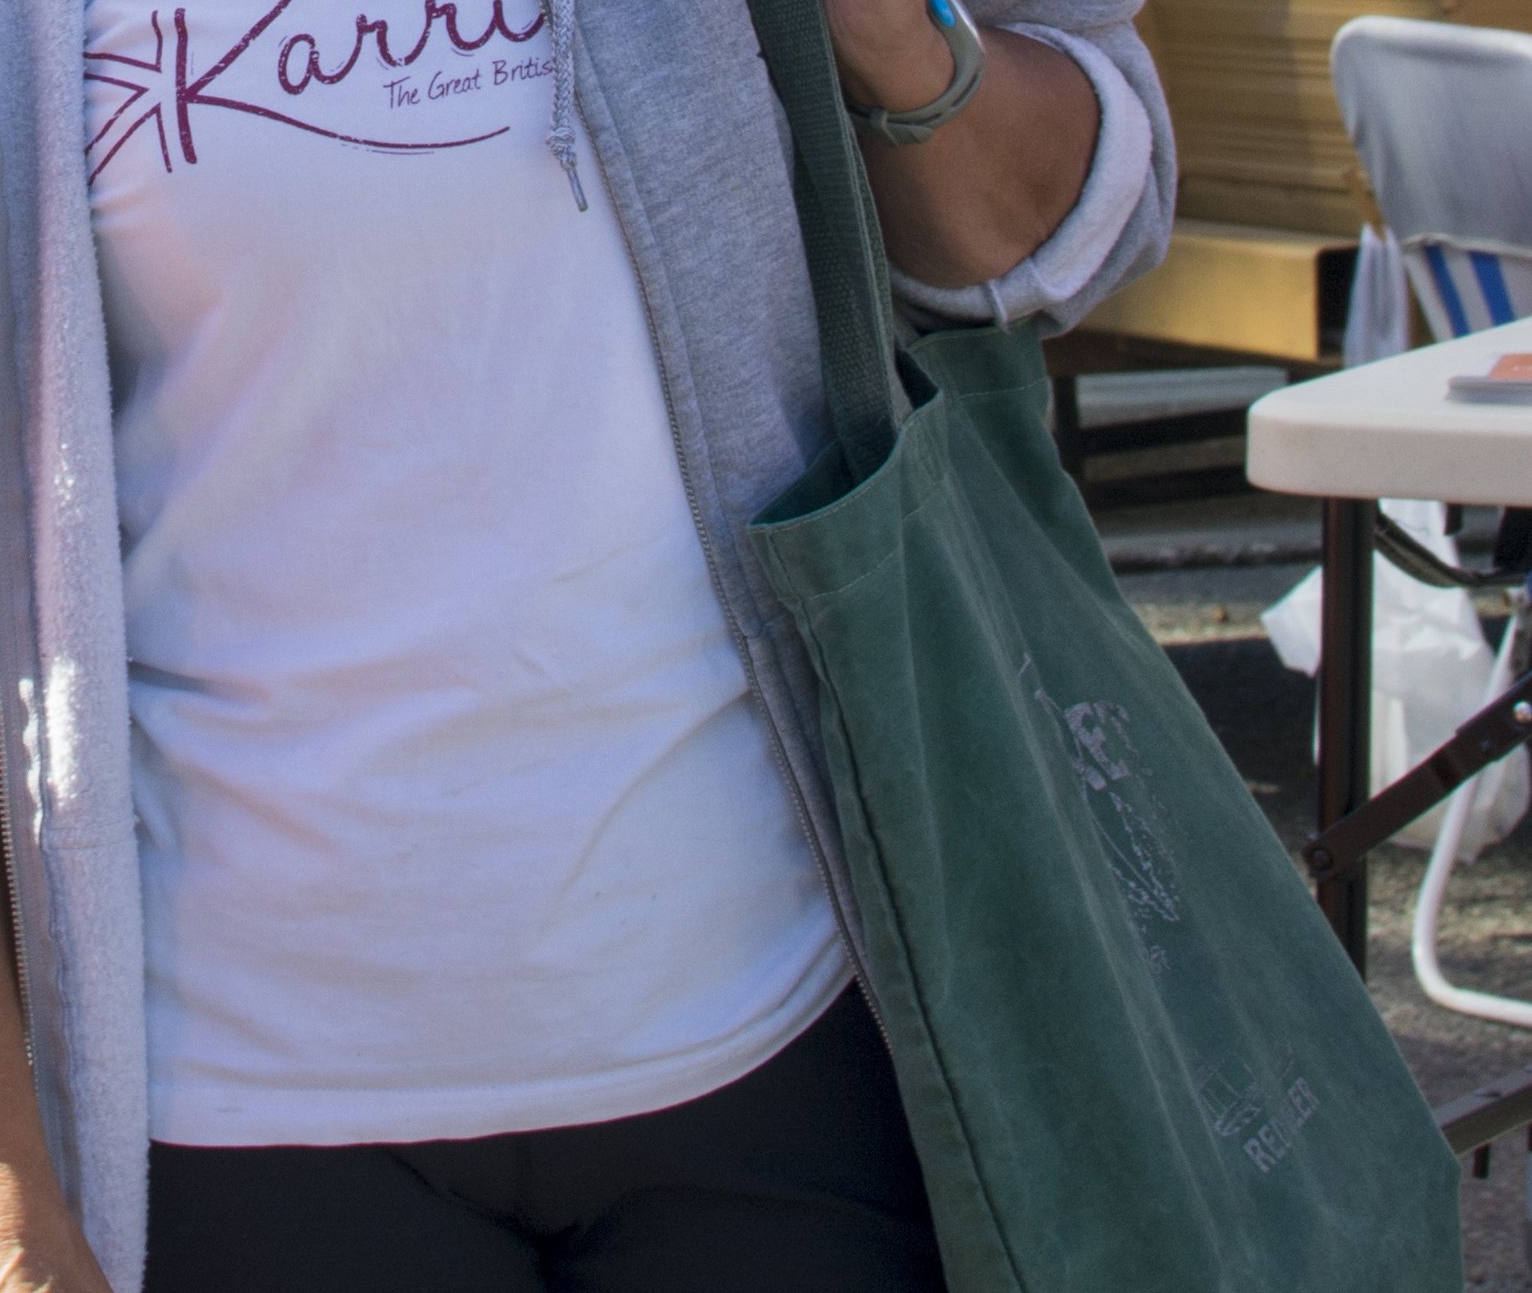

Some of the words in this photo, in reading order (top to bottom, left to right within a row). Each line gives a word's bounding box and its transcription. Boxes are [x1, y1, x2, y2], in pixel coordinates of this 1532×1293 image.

[383, 76, 421, 108] The
[428, 68, 482, 100] Great
[492, 58, 554, 86] Britis
